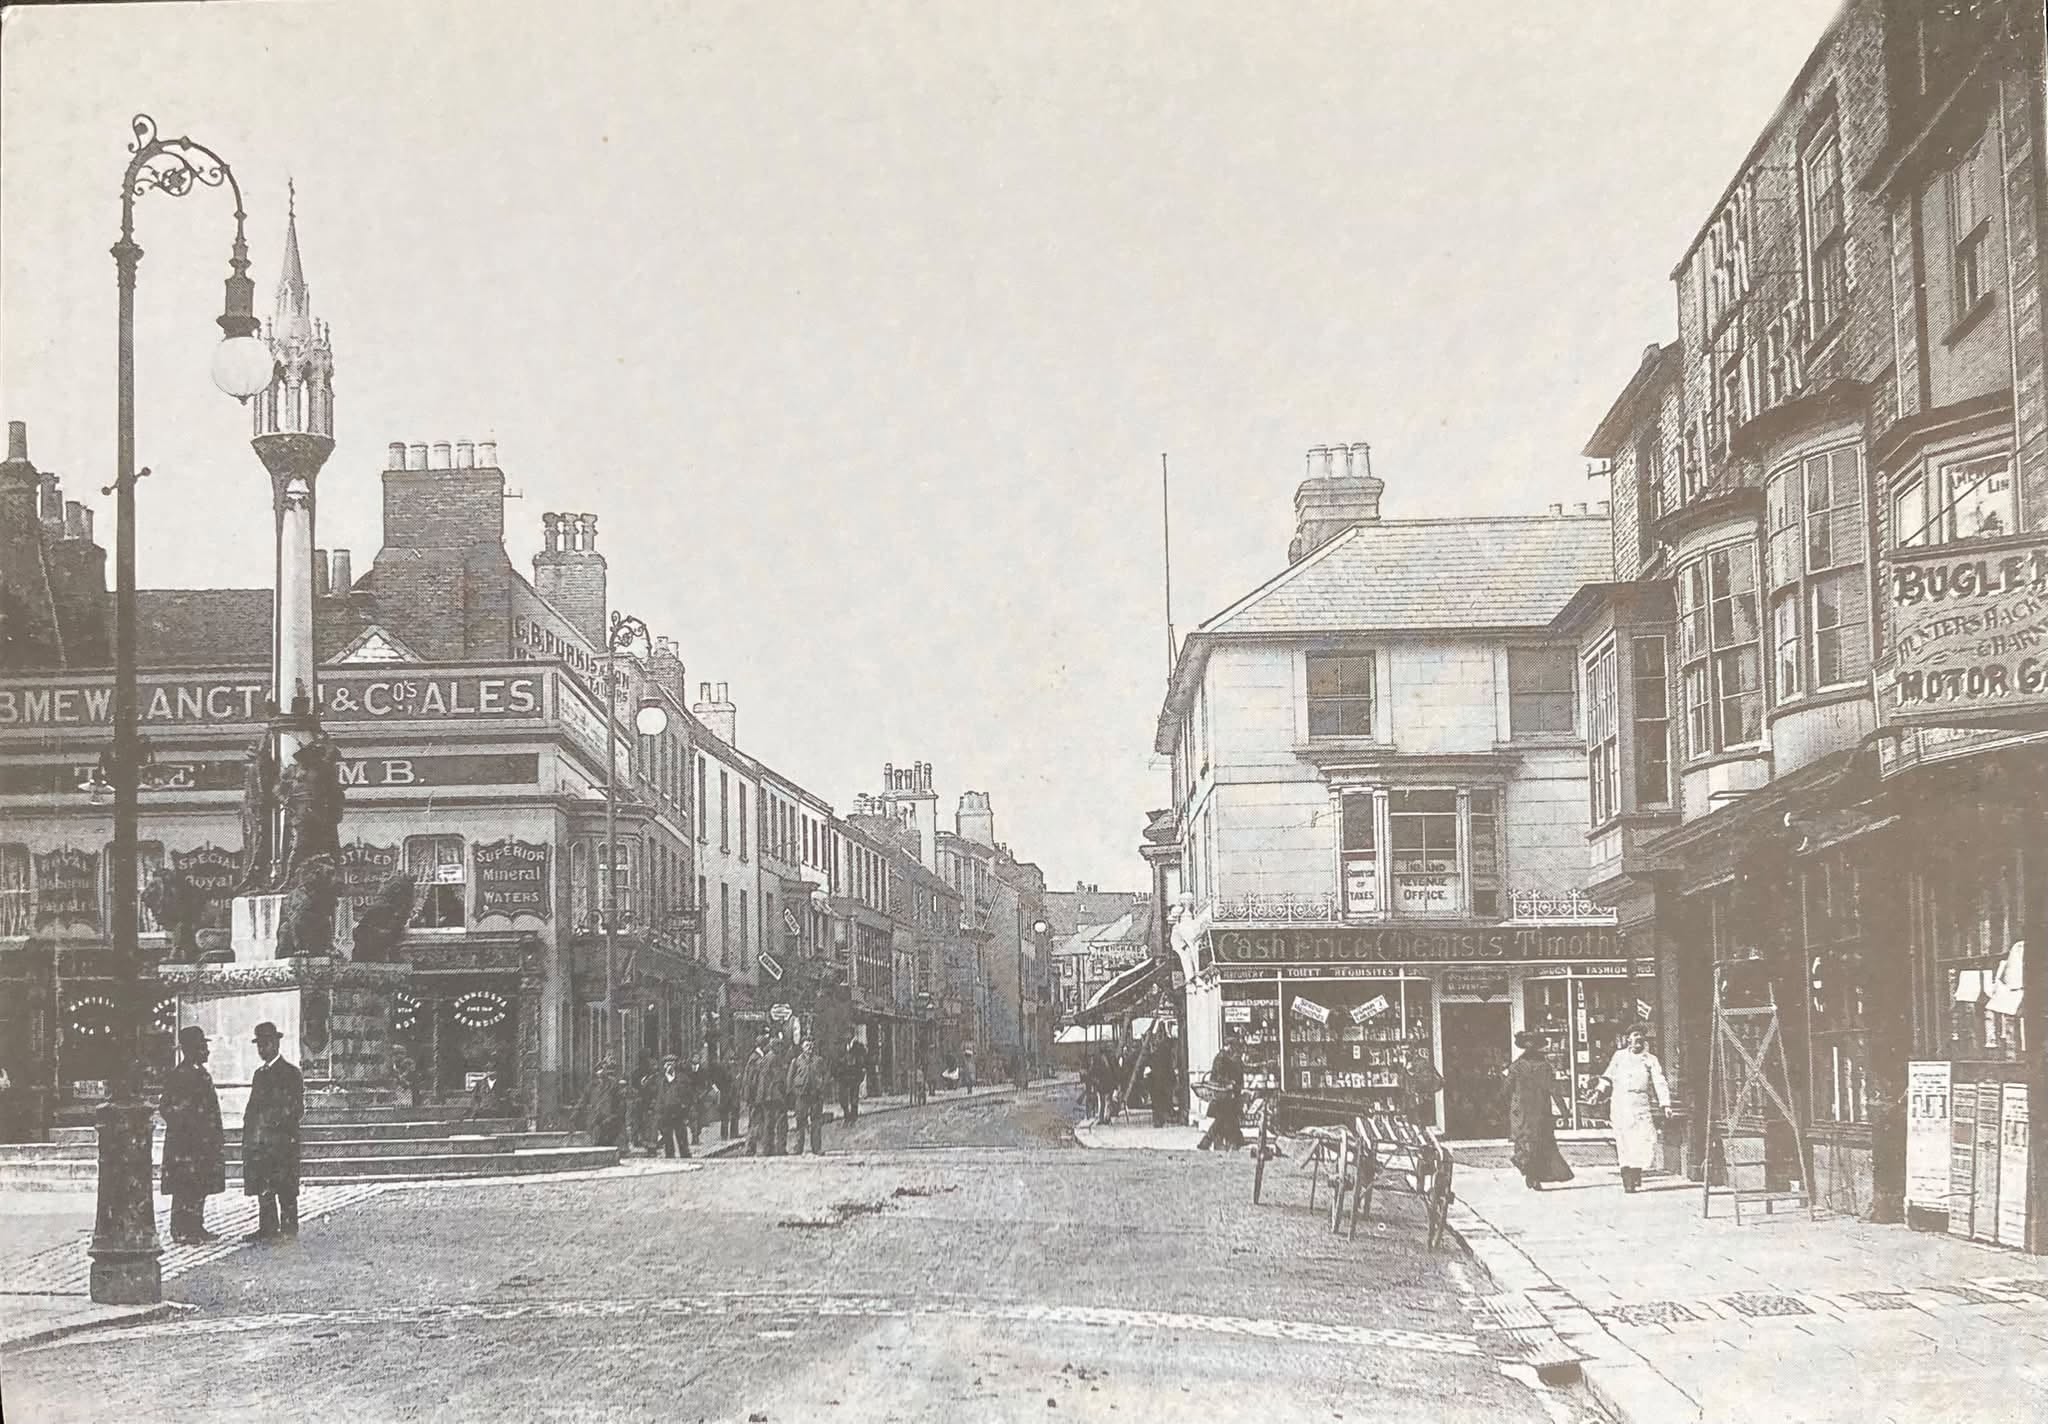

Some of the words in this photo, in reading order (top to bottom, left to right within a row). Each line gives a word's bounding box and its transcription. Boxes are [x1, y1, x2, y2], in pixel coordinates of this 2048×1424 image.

[1897, 663, 2010, 706] MOTOR
[2016, 656, 2048, 695] G
[331, 687, 359, 711] &
[178, 853, 241, 872] SPECIAL
[475, 847, 545, 863] SUPERIOR
[483, 867, 541, 881] Mineral
[1400, 877, 1448, 888] REVENUE
[483, 892, 540, 903] WATERS
[1350, 890, 1375, 901] TAXES
[1218, 931, 1286, 962] Cash
[1288, 968, 1321, 977] TOILET
[1334, 967, 1395, 978] REQUISITES
